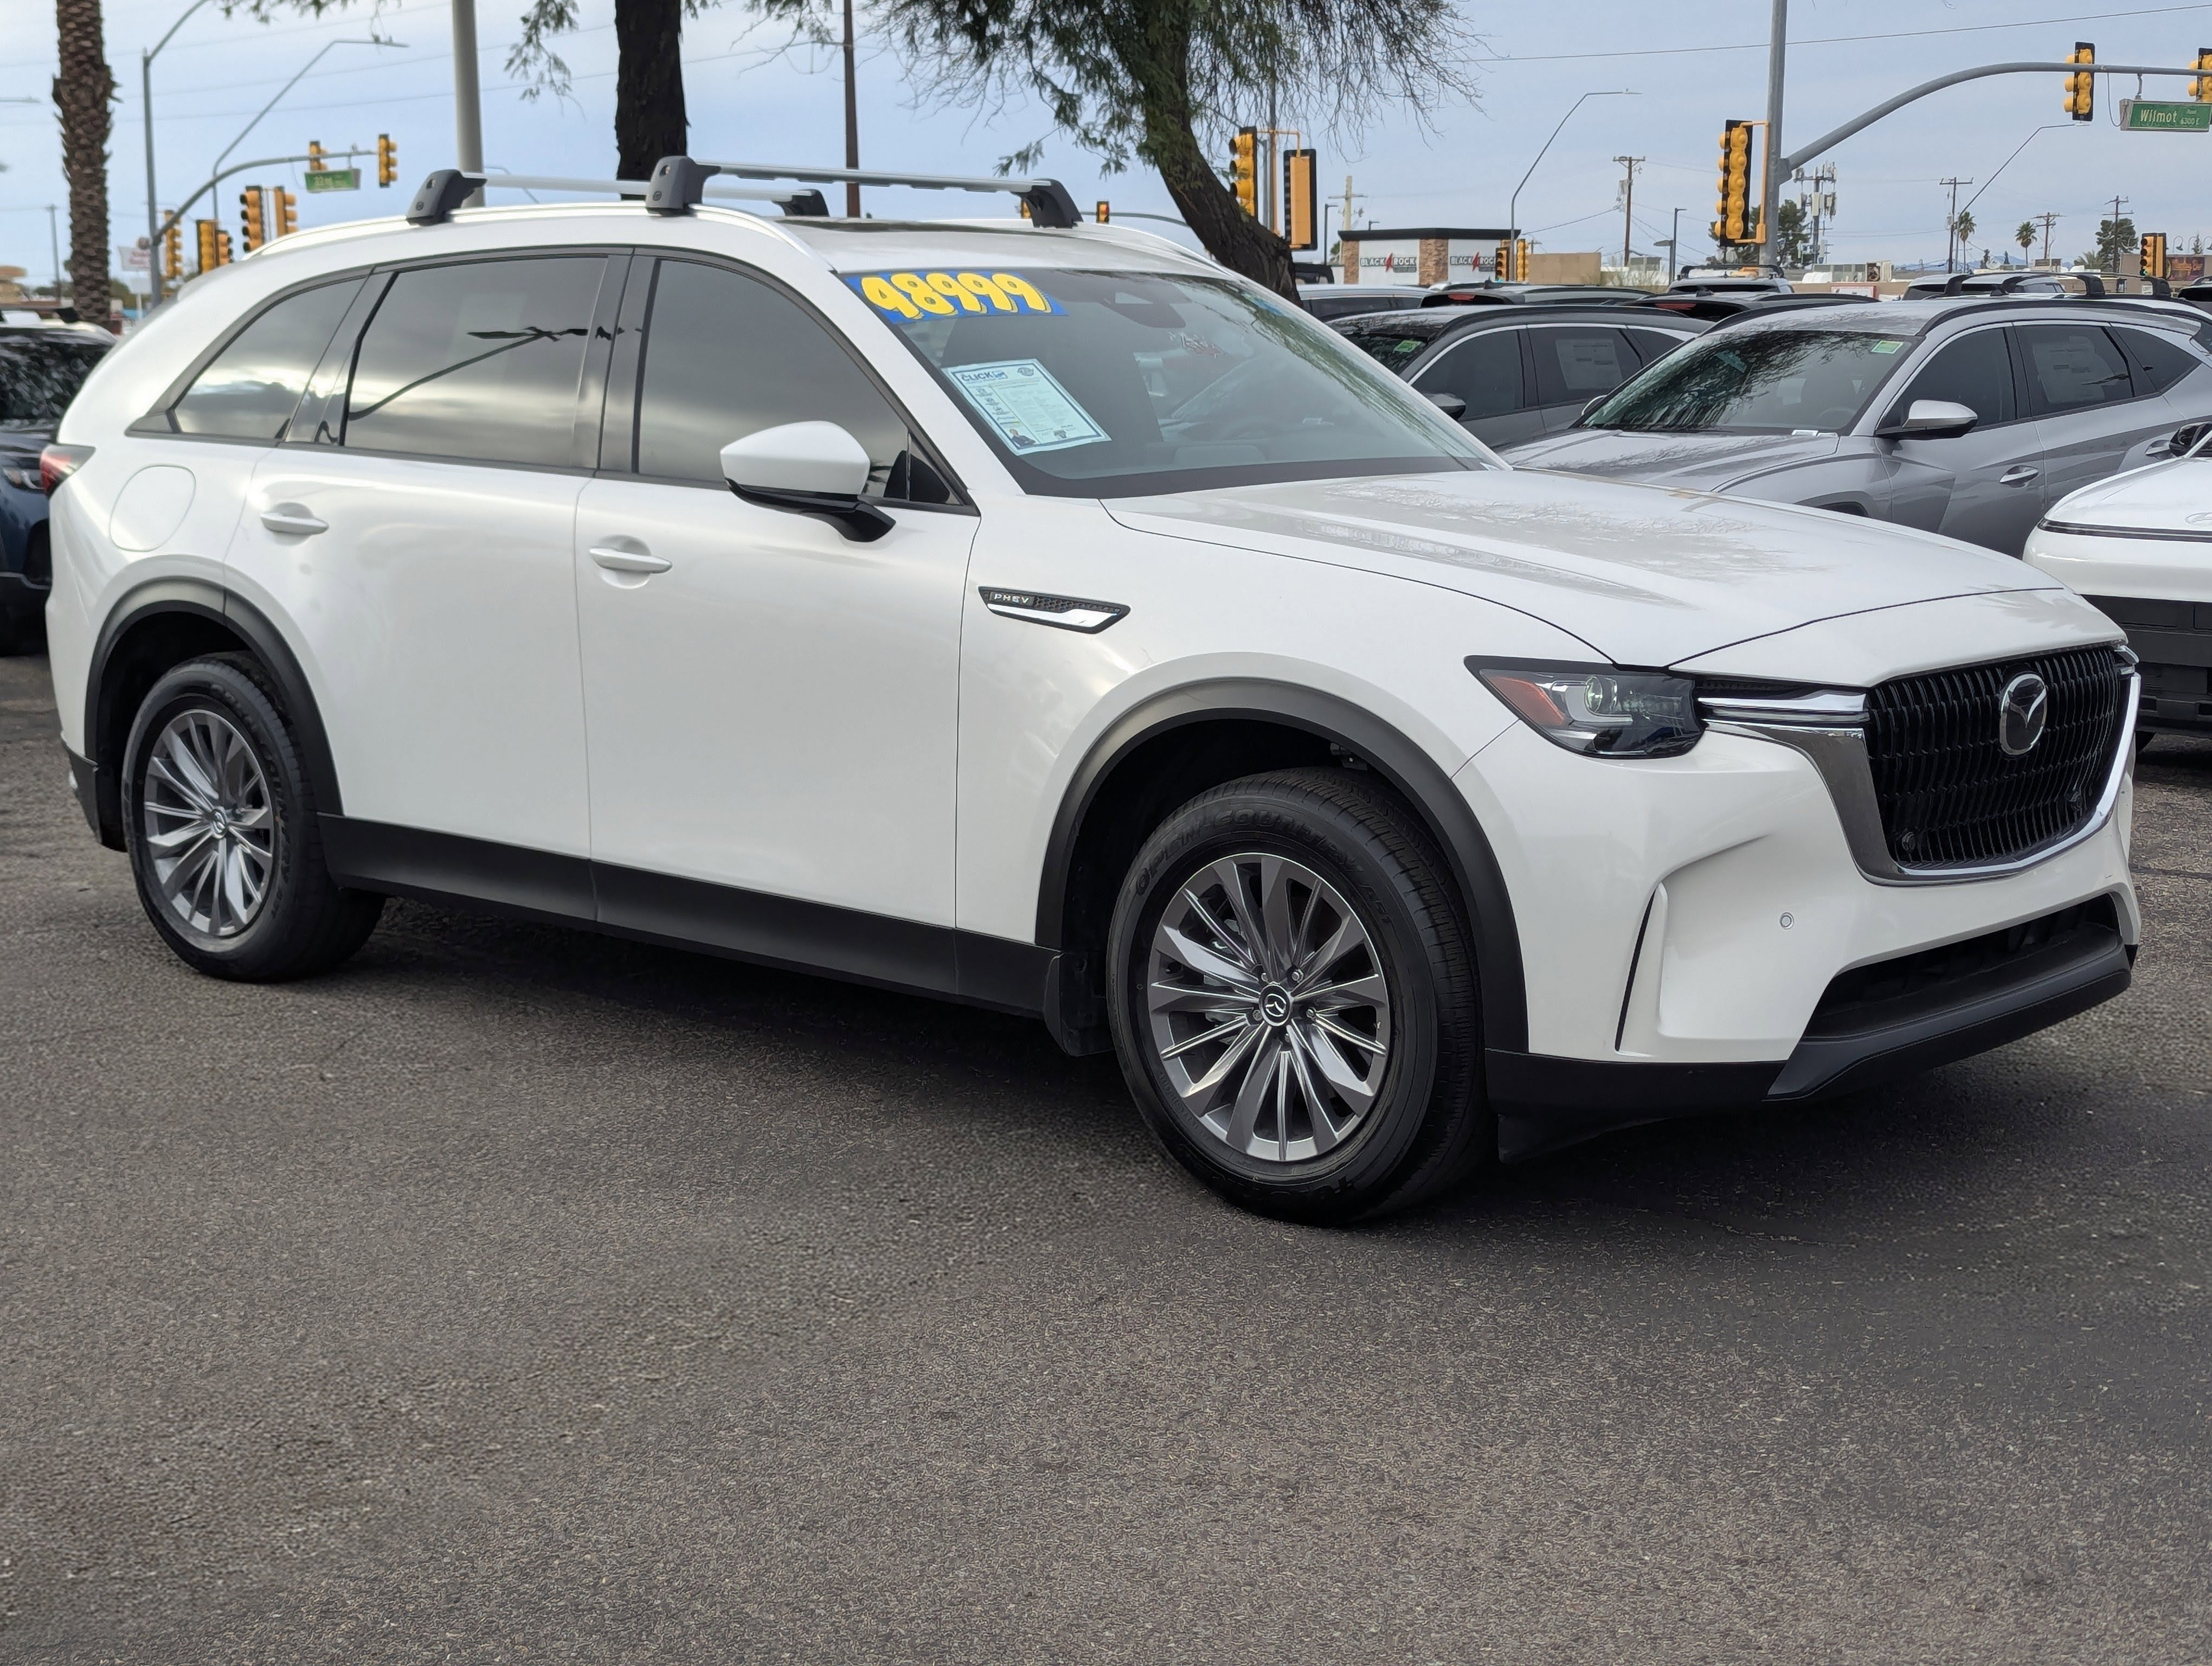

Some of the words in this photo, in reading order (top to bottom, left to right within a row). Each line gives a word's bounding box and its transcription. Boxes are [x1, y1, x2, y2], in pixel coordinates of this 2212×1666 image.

[2140, 109, 2177, 123] Wilmot
[1360, 257, 1385, 266] BLACK
[1394, 258, 1416, 266] ROCK
[1450, 257, 1472, 265] BLACK
[861, 273, 1051, 319] 48999
[962, 371, 993, 381] CLICK
[994, 593, 1029, 604] PHEV
